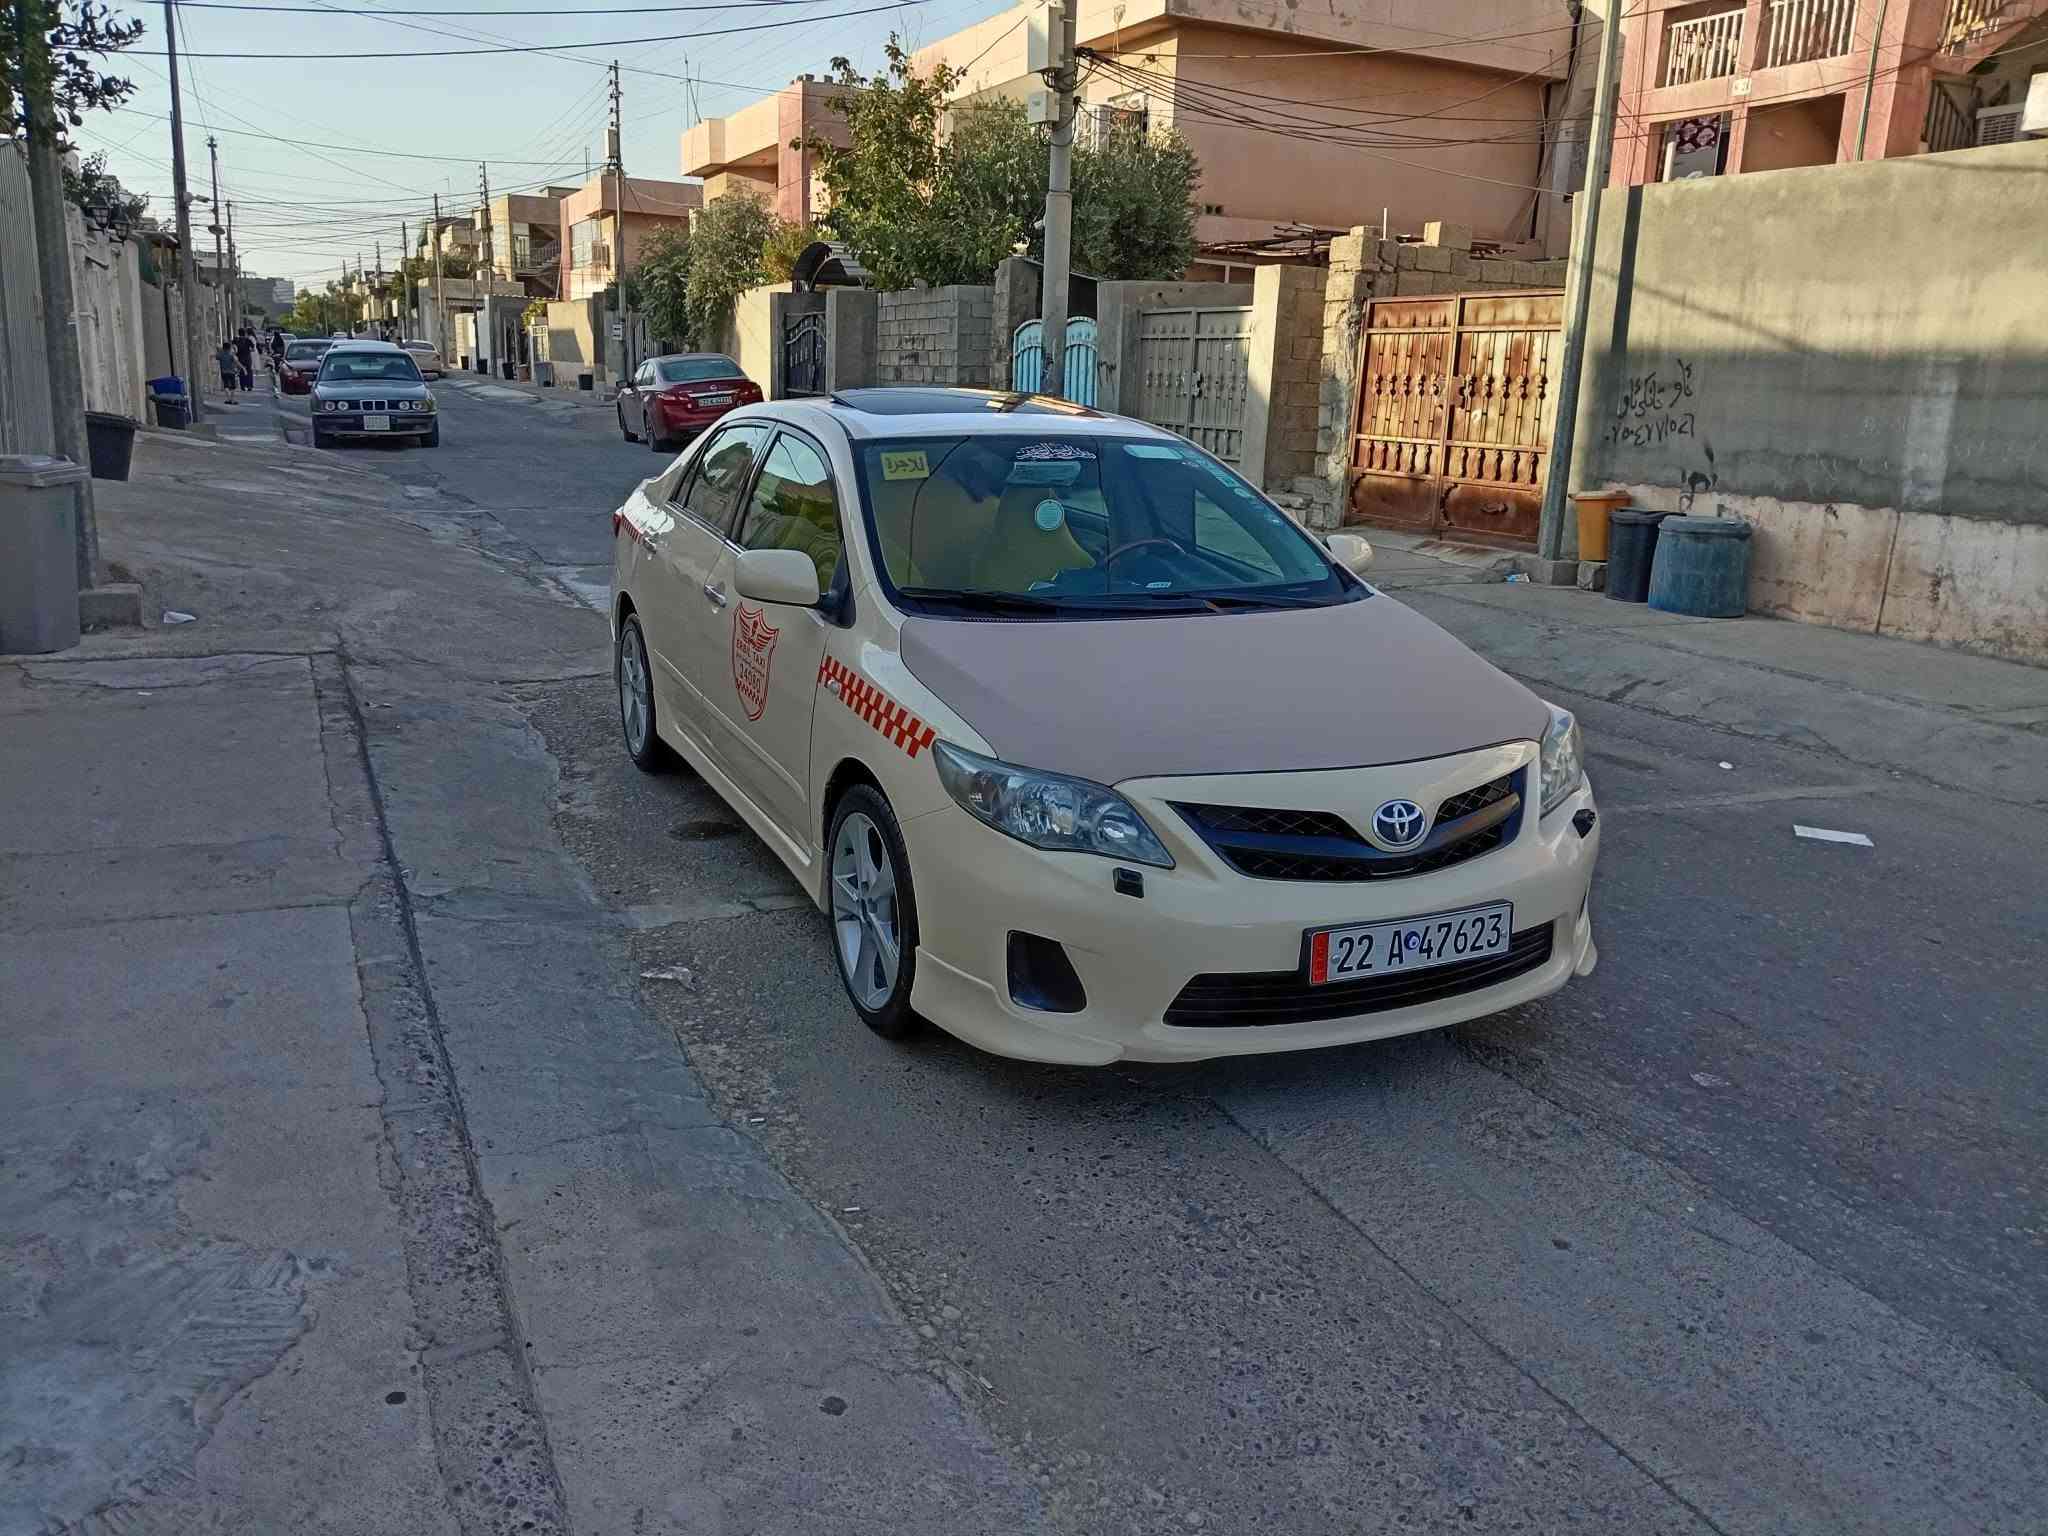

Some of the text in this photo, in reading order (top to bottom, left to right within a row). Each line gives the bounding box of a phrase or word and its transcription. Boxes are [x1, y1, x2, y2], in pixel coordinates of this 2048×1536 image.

[1337, 934, 1374, 973] 22
[1387, 929, 1405, 967] A
[1418, 913, 1503, 960] 47623
